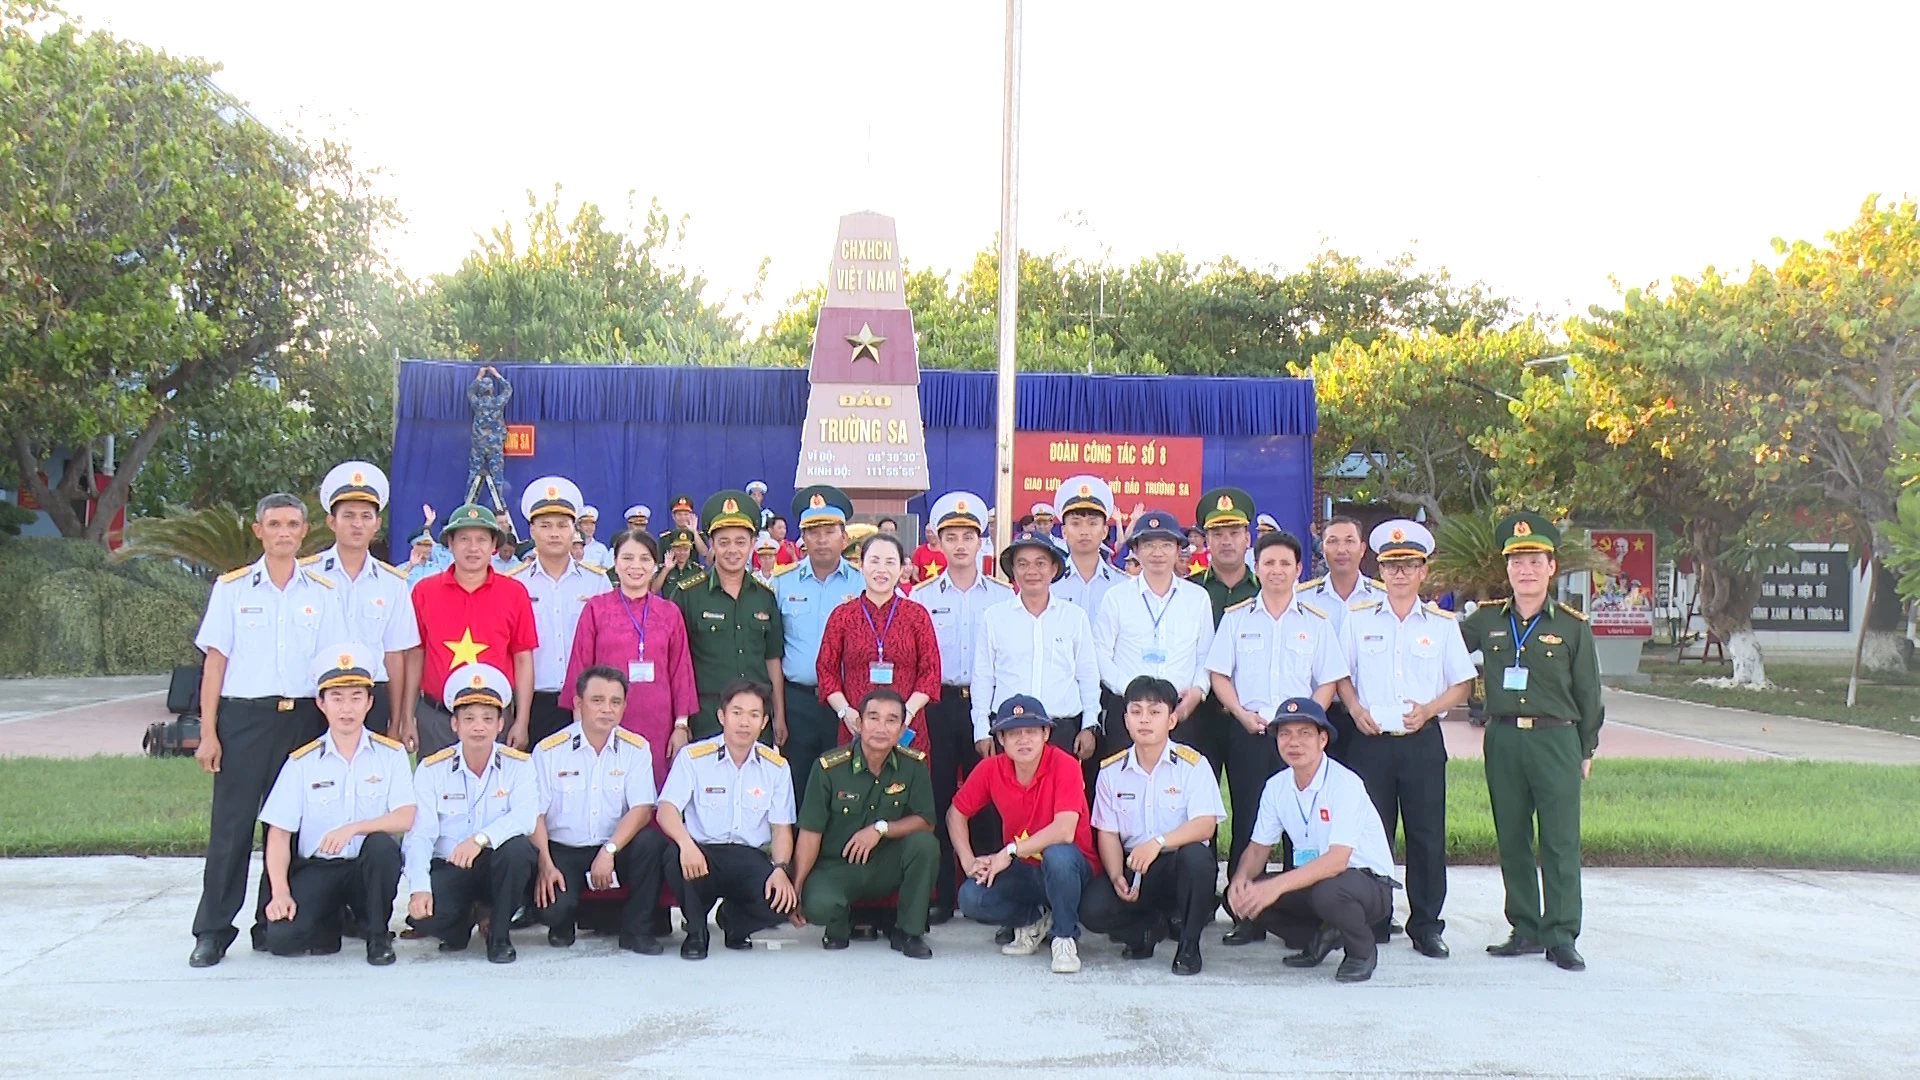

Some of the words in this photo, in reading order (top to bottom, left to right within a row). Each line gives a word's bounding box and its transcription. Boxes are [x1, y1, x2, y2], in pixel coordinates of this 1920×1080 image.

[841, 239, 892, 260] CHXHCN
[836, 264, 864, 296] VIỆT
[866, 269, 897, 292] NAM
[839, 389, 892, 408] ĐẢO
[819, 413, 882, 443] TRƯỜNG
[887, 418, 908, 444] SA
[1049, 439, 1079, 462] ĐOÀN
[1083, 439, 1111, 464] CÔNG
[1117, 441, 1136, 464] TÁC
[1141, 439, 1156, 465] SỐ
[806, 465, 832, 476] KINH
[1024, 477, 1042, 491] GIAO
[1124, 476, 1140, 494] ĐẢO
[1145, 477, 1176, 496] TRƯỜNG
[1178, 481, 1190, 496] SA
